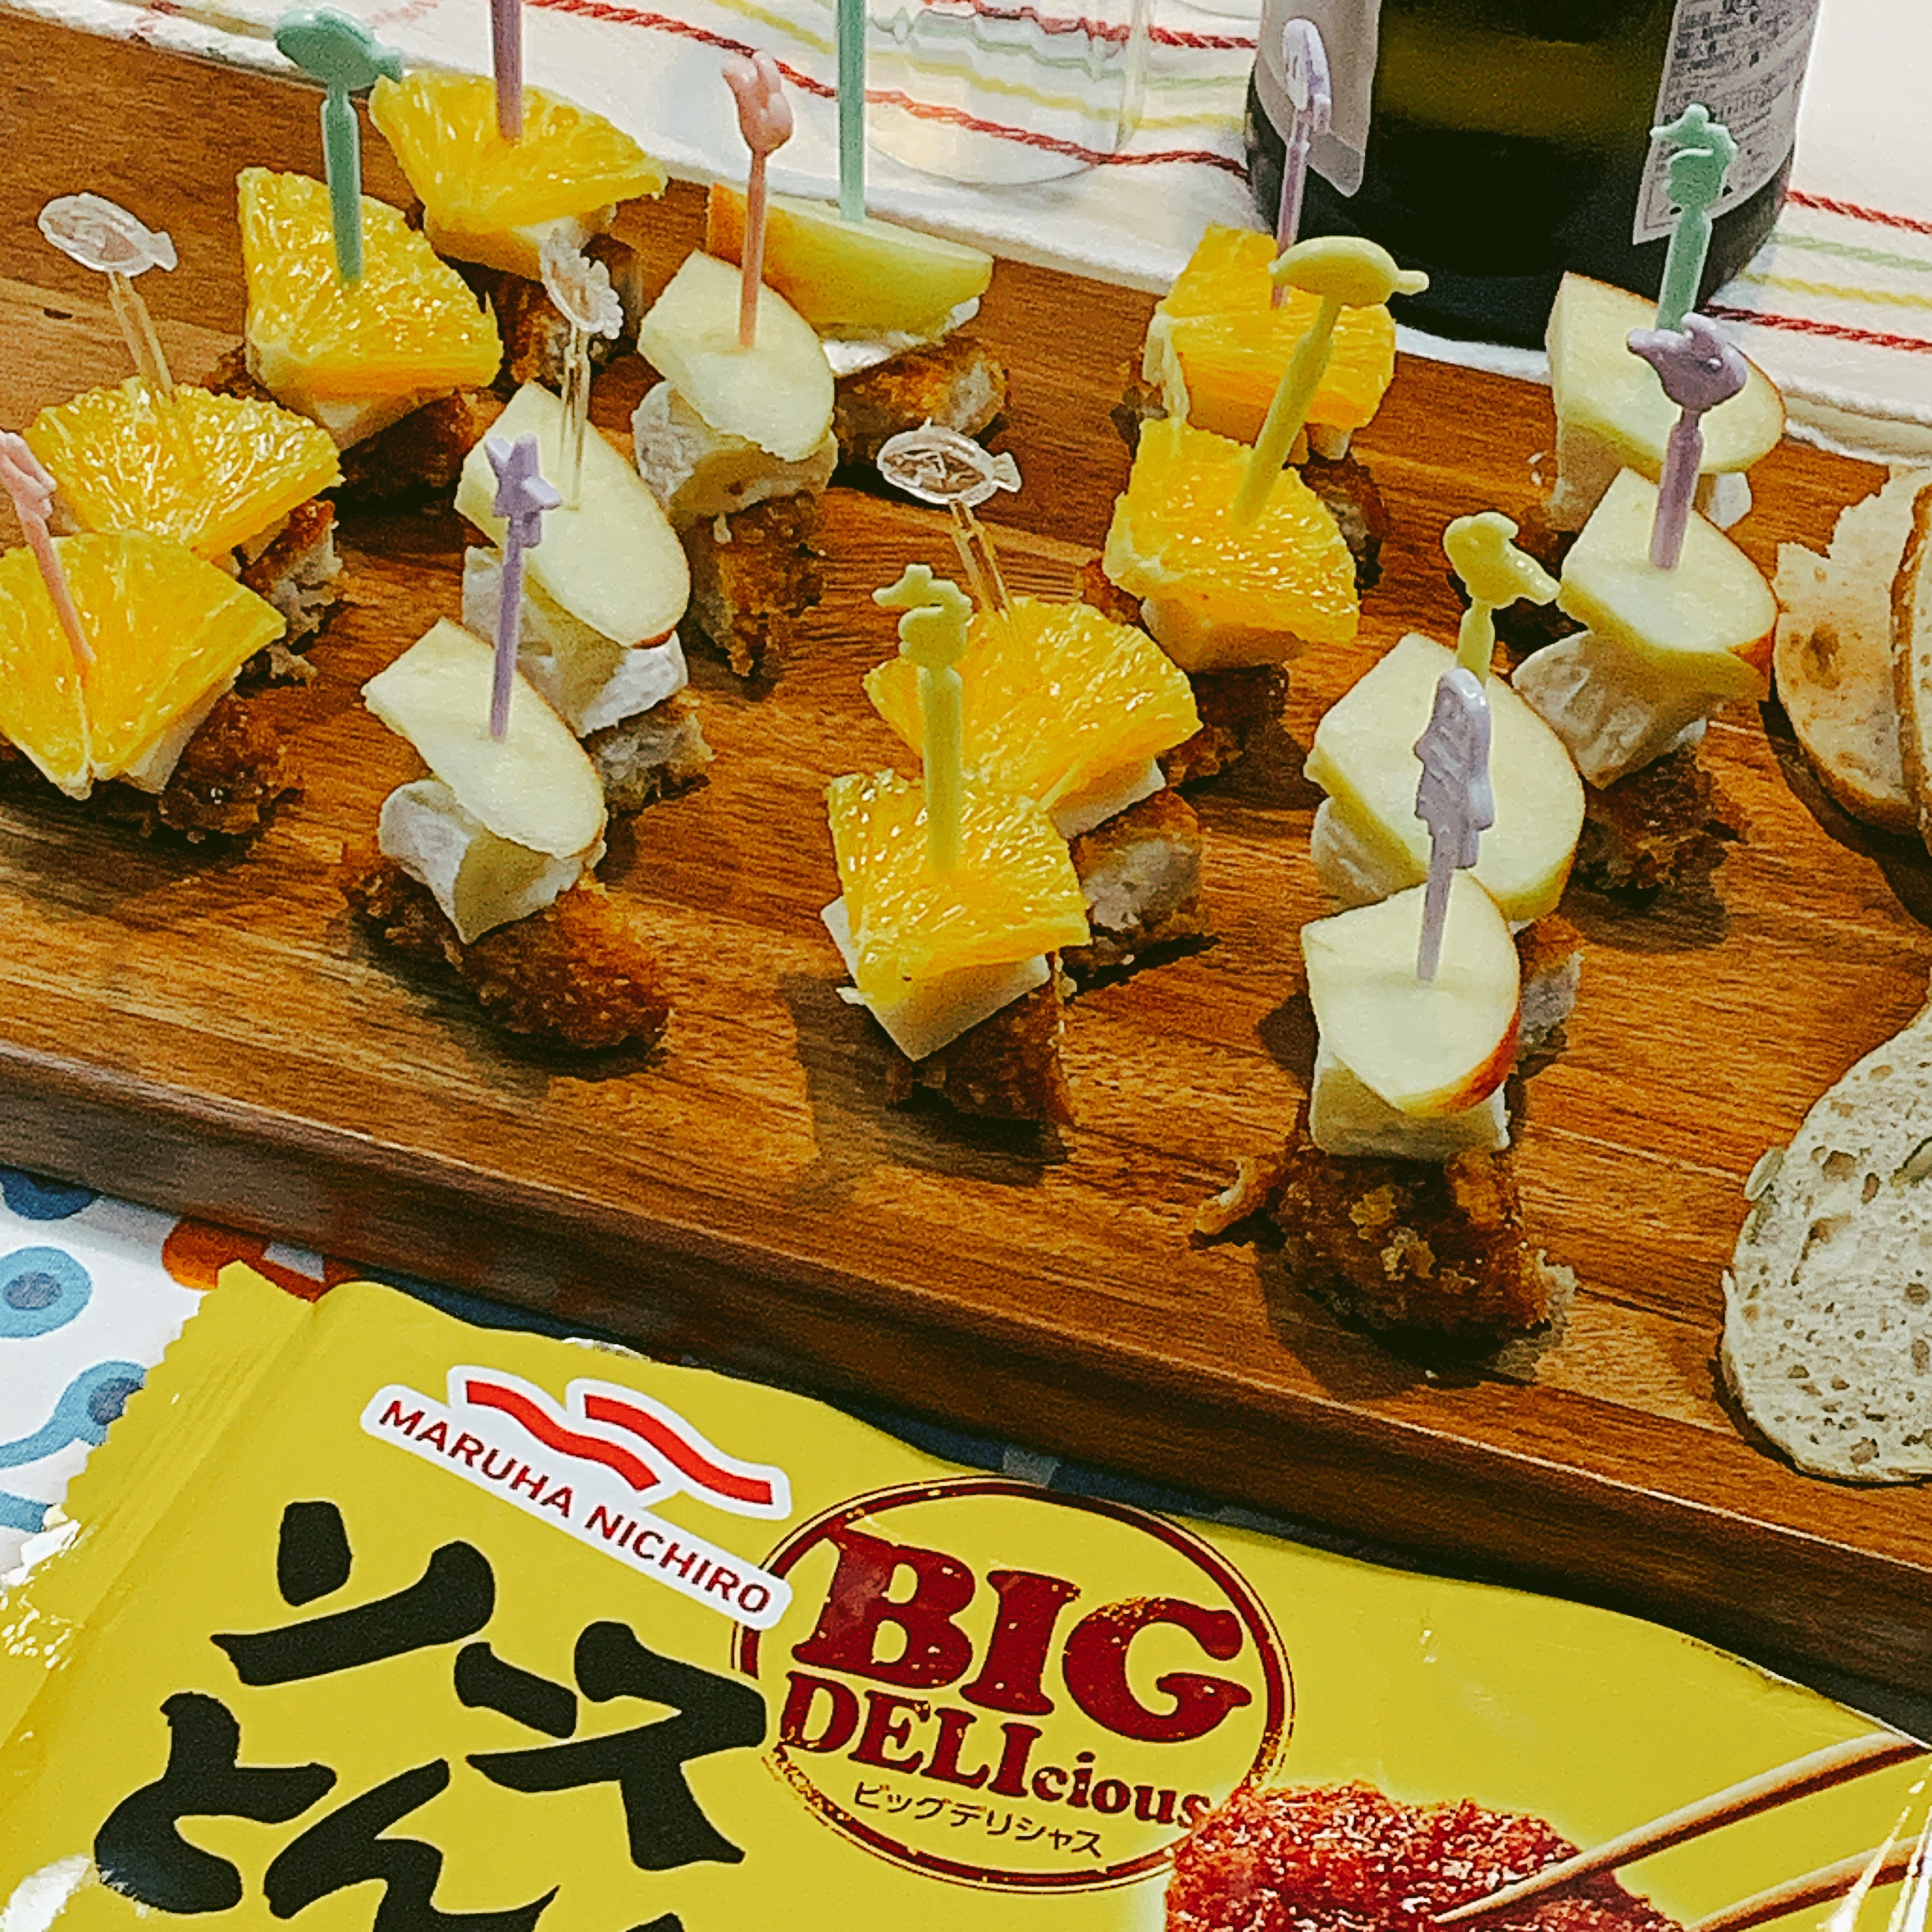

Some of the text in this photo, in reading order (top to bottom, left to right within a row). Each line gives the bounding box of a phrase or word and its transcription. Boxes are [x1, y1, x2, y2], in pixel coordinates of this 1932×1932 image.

[379, 1400, 771, 1613] MARUHA NICHIRO
[210, 1501, 766, 1871] ソース
[792, 1530, 1252, 1743] BIG
[94, 1692, 686, 1932] とん
[779, 1671, 1211, 1828] DELIcious
[854, 1781, 1102, 1859] ビッグデリシャス
